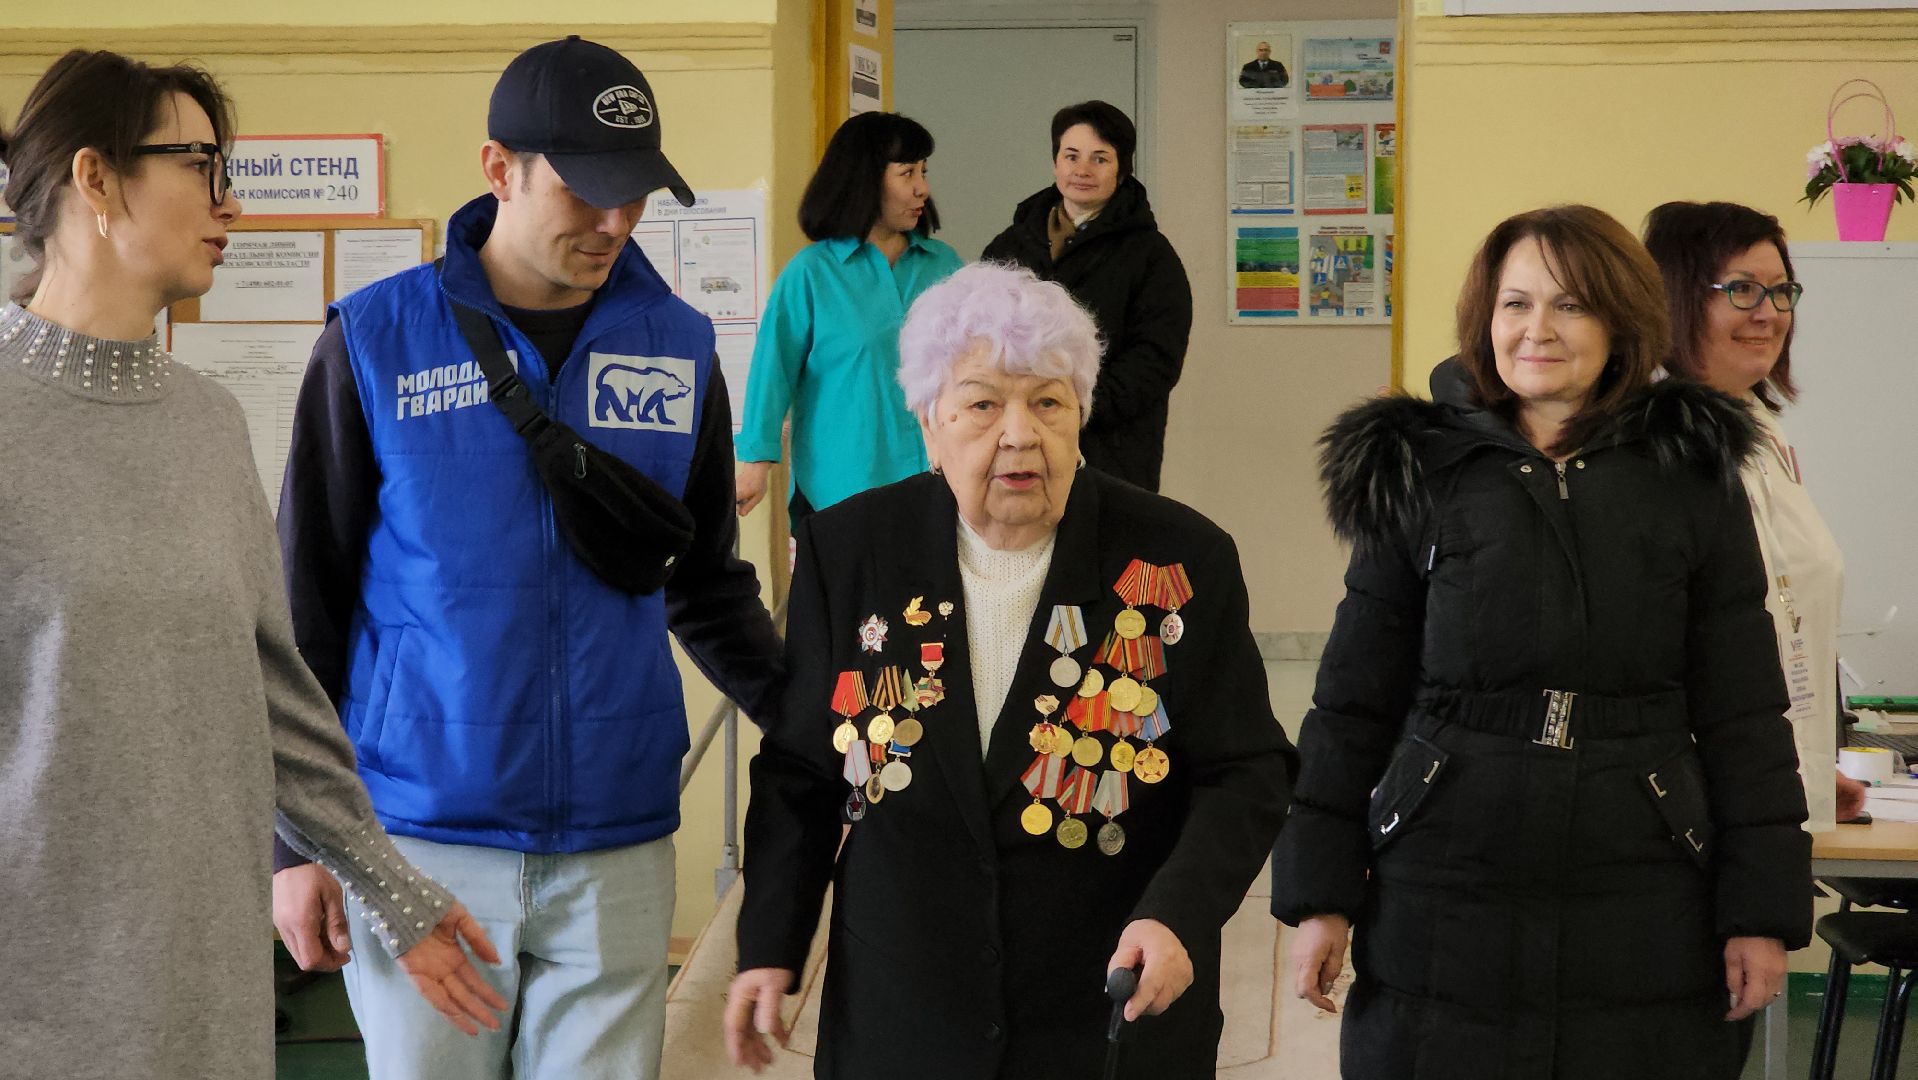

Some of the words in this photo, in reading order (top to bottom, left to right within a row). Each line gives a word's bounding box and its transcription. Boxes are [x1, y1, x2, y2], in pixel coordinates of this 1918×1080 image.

[227, 153, 283, 176] ННЫЙ
[290, 157, 359, 179] СТЕНД
[232, 190, 245, 199] АЯ
[248, 188, 310, 199] КОМИССИЯ
[327, 185, 358, 201] 240
[396, 380, 491, 421] ГВАРДИ
